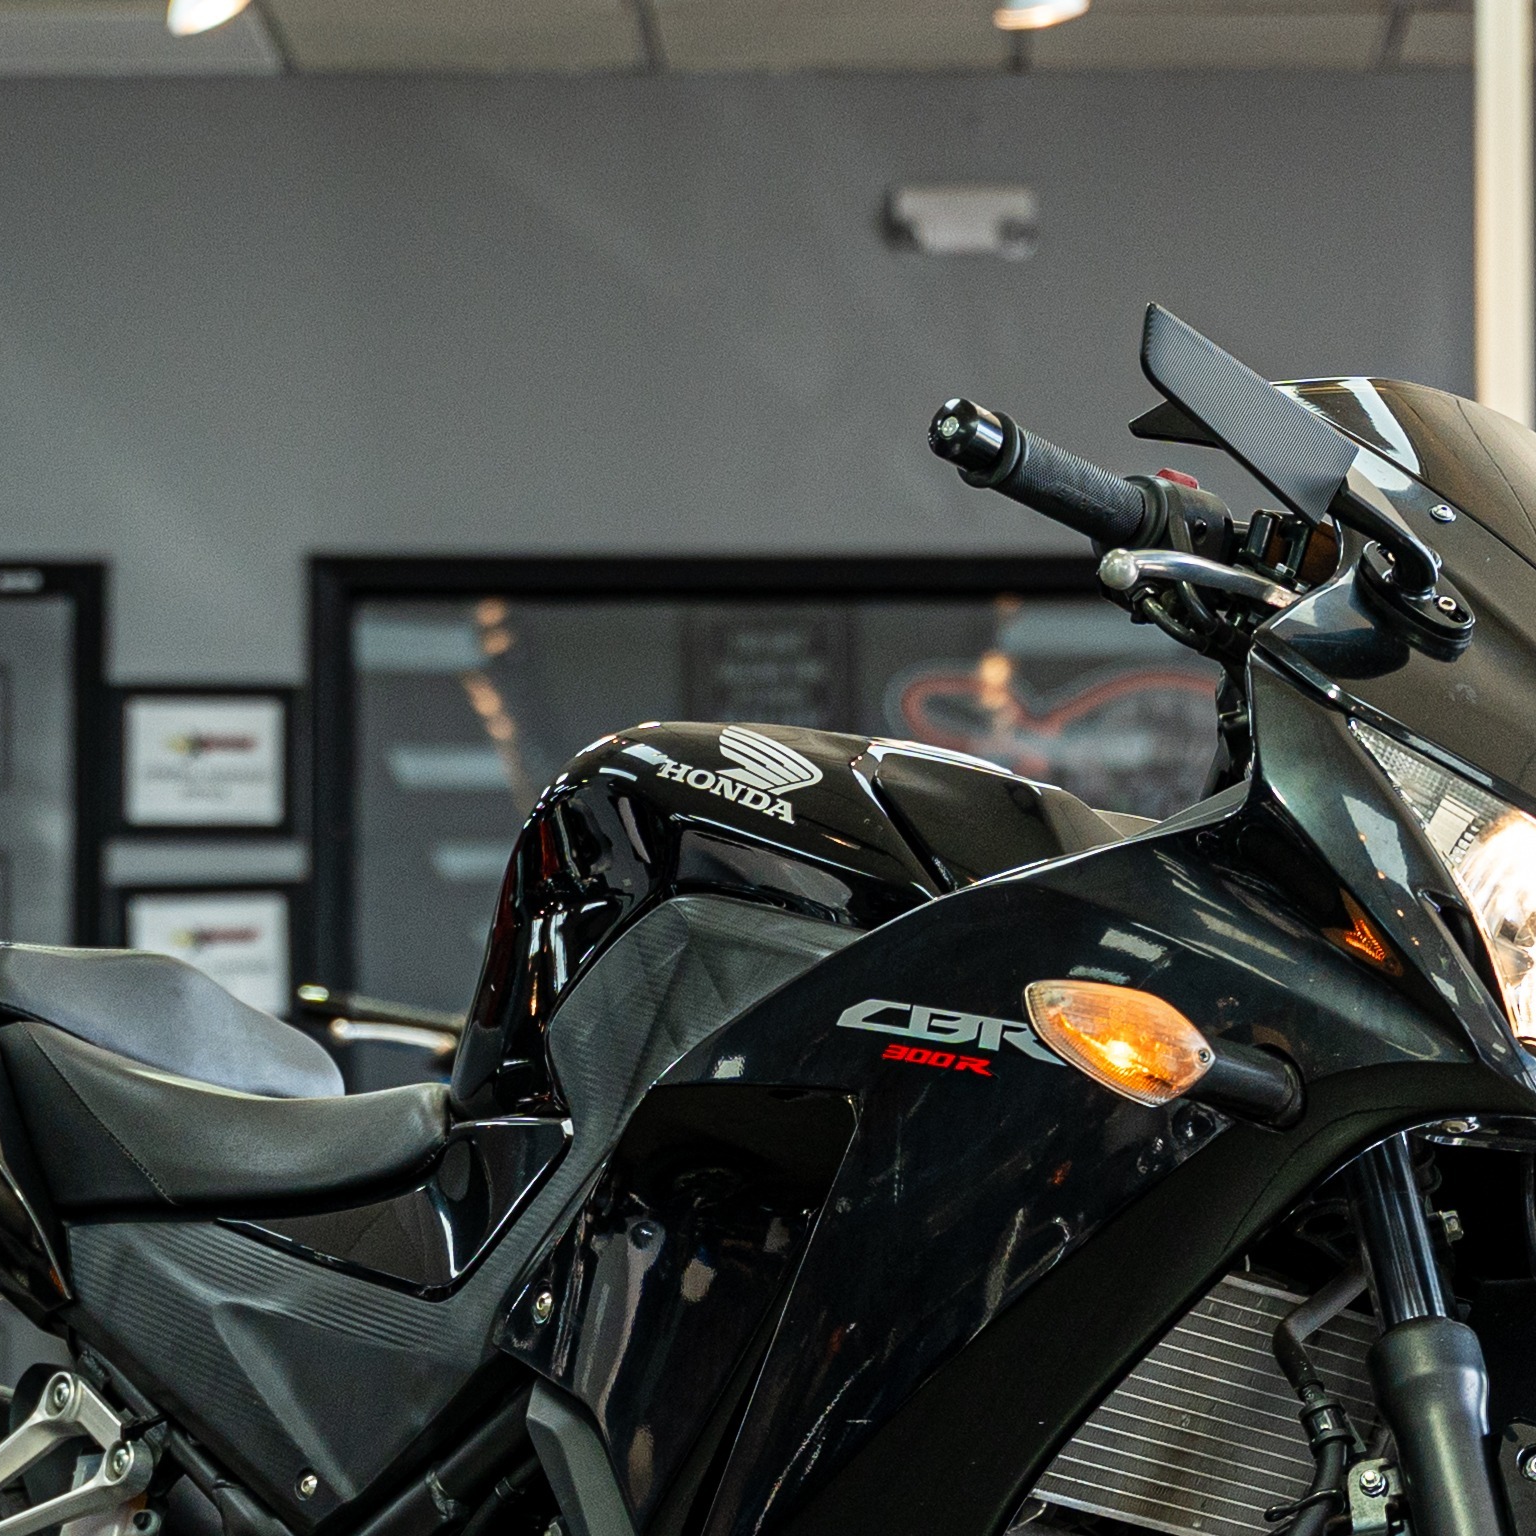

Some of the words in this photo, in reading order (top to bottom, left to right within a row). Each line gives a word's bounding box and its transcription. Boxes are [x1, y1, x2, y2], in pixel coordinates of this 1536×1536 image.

[657, 759, 796, 824] HONDA
[837, 998, 1068, 1066] CBR
[881, 1044, 994, 1077] 300R
